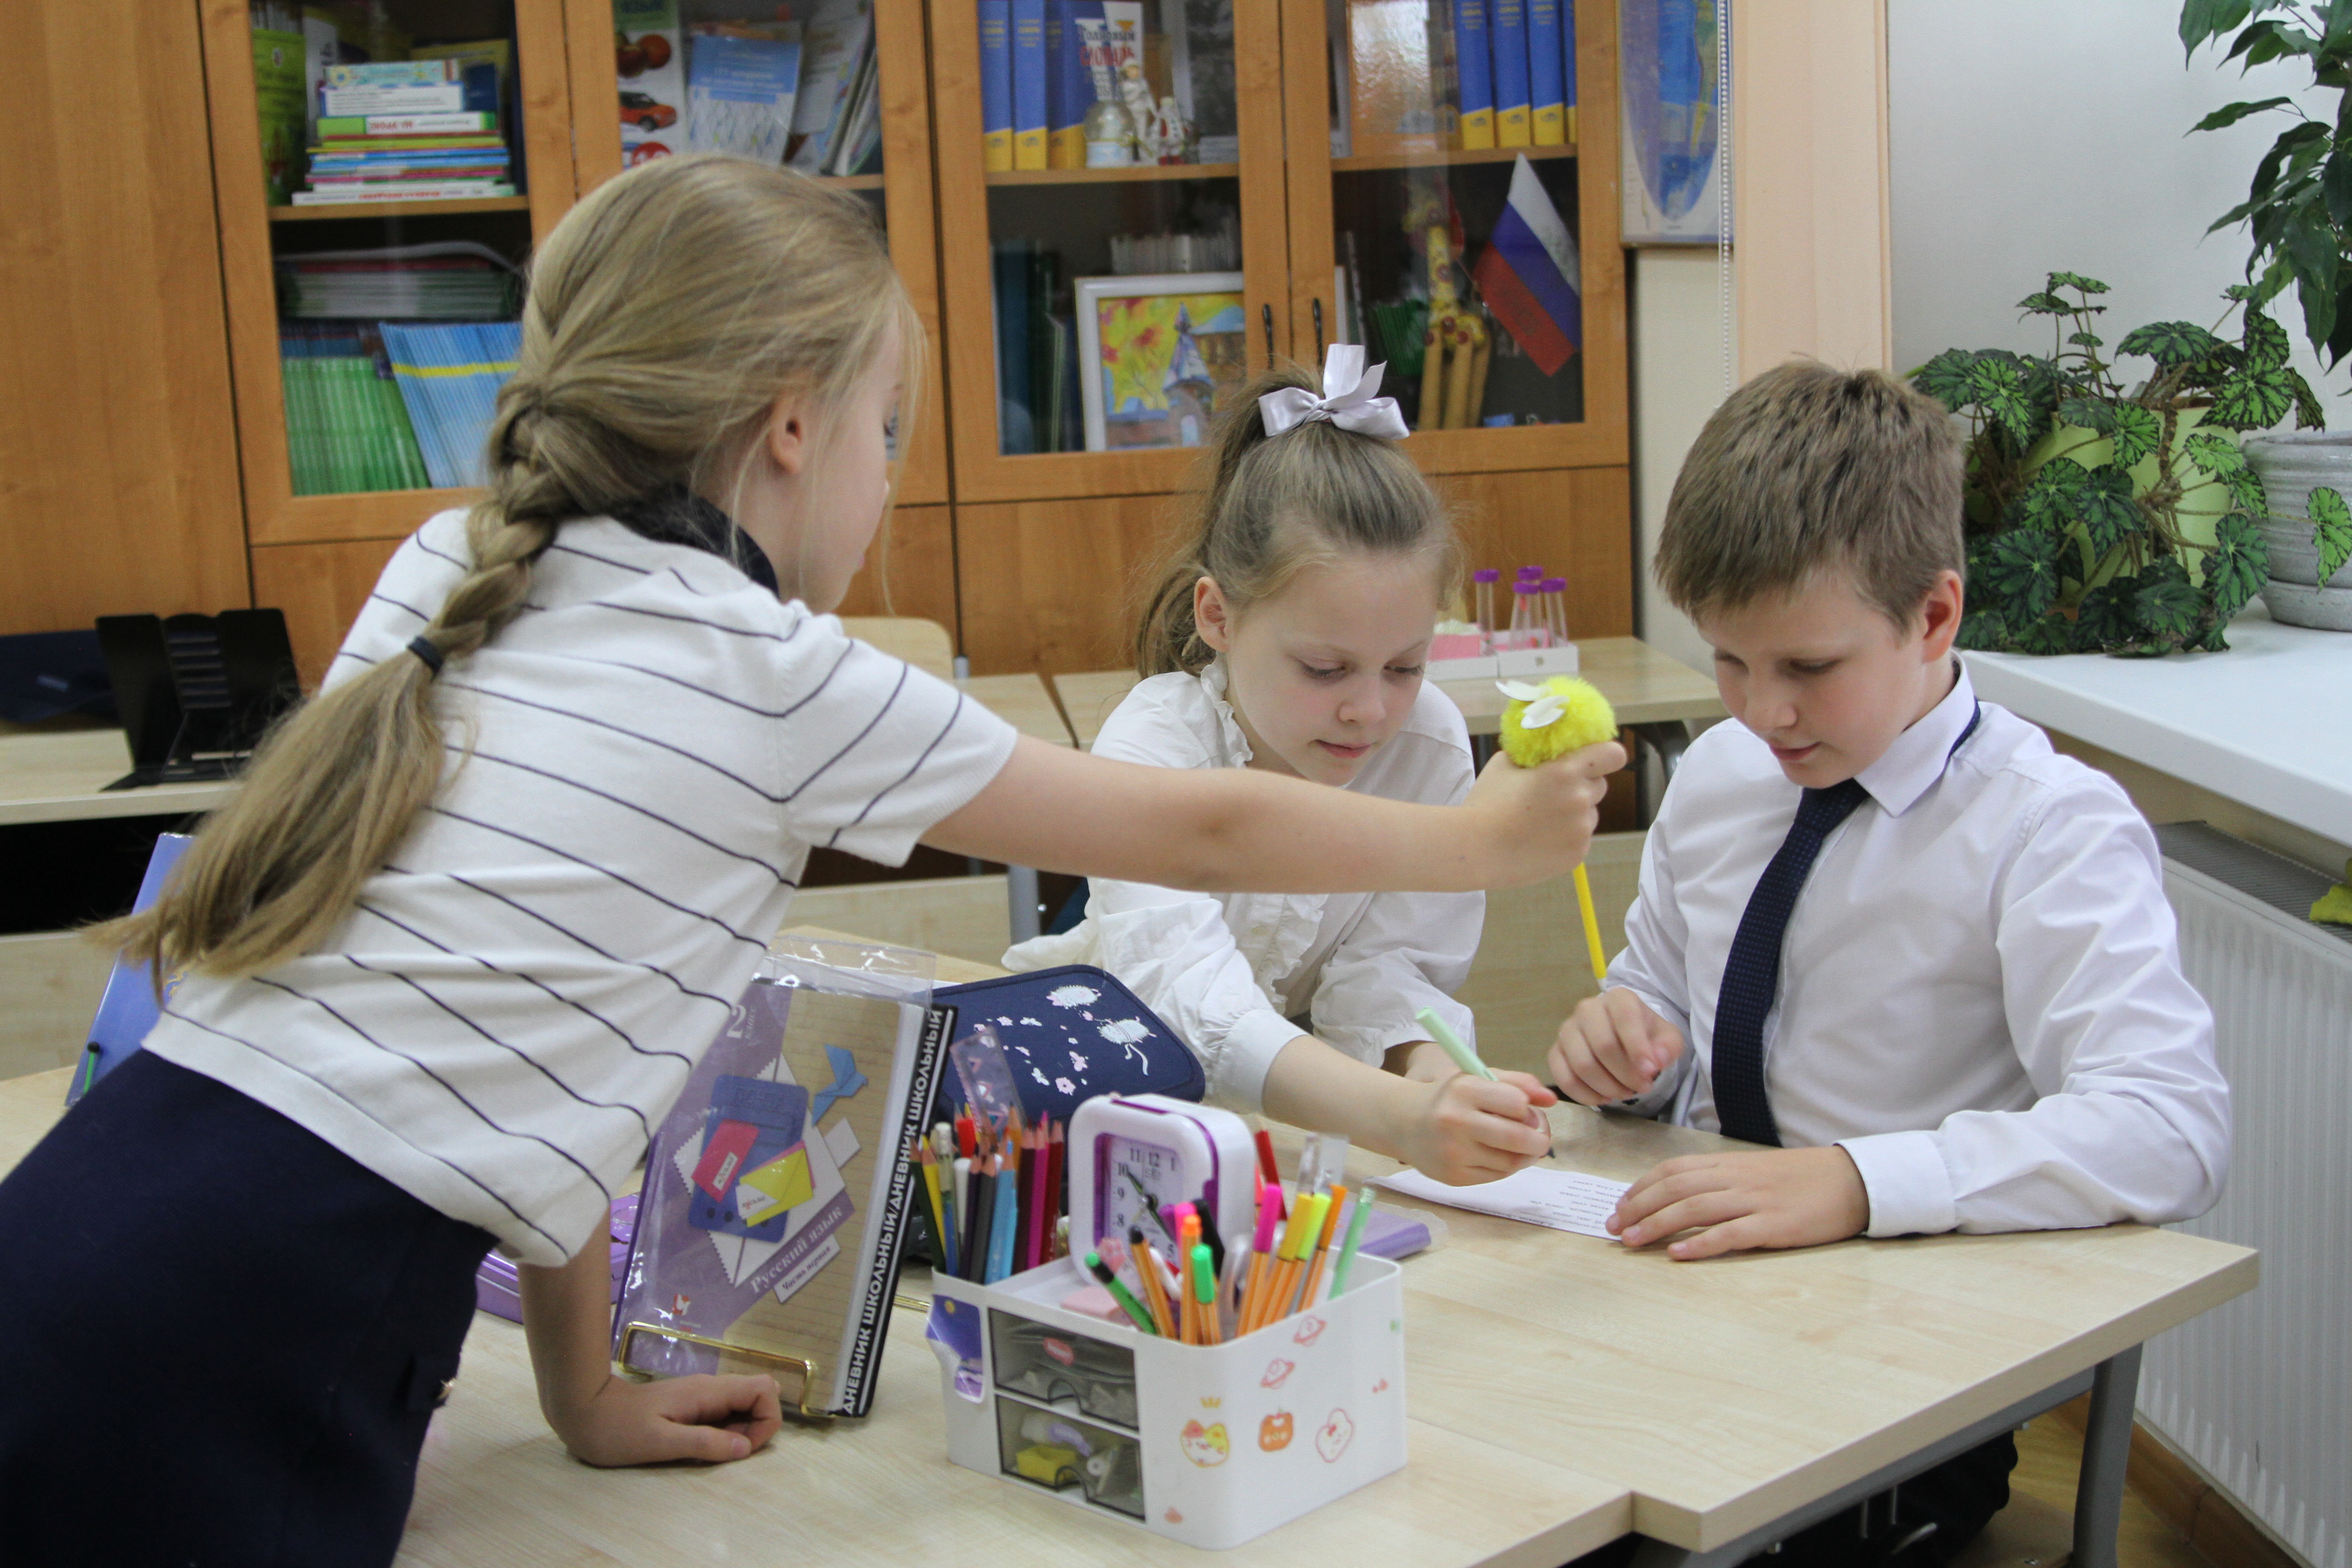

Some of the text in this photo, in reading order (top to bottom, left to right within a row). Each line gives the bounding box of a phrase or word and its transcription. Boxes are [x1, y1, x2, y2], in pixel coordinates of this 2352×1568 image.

[727, 1005, 746, 1039] 2
[1130, 1147, 1140, 1163] 11
[1148, 1152, 1160, 1168] 12
[1117, 1187, 1125, 1199] 9
[843, 1328, 872, 1415] ДНЕВНИК
[907, 1009, 943, 1121] ШКОЛЬНЫЙ
[1117, 1213, 1125, 1229] 8
[750, 1206, 843, 1293] Русский язык
[782, 1246, 831, 1290] Часть первая
